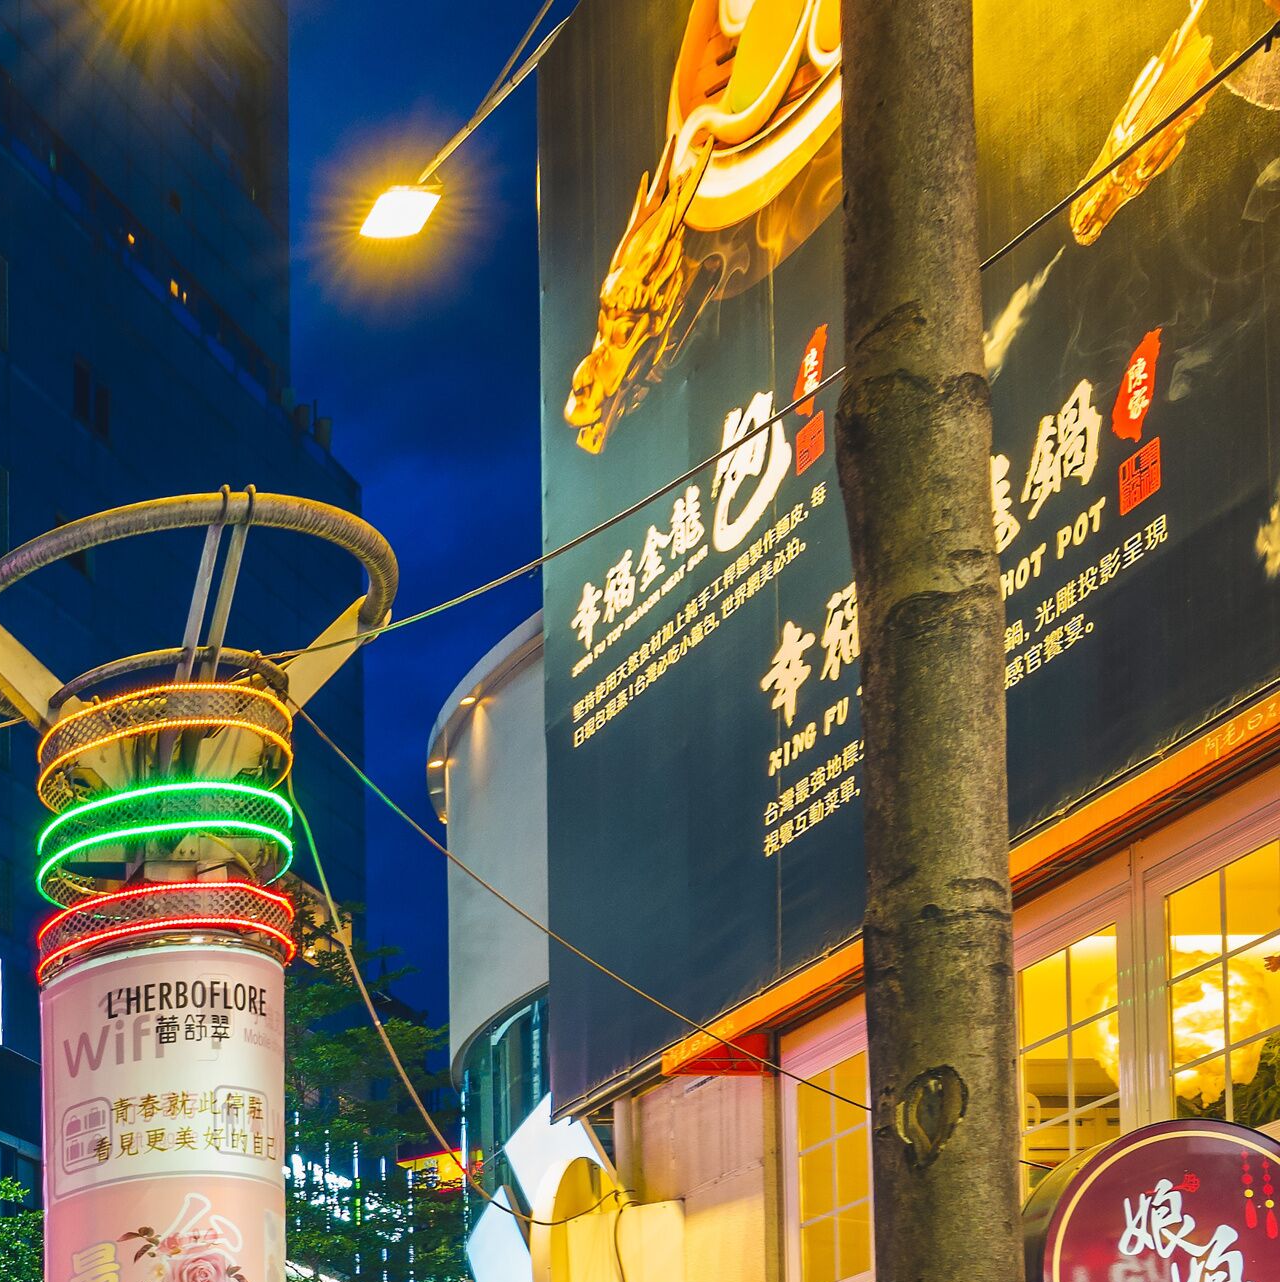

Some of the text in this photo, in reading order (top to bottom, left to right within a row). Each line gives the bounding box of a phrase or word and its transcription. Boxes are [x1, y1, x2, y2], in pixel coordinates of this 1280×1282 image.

[1001, 496, 1108, 602] HOT POT
[155, 1014, 231, 1045] 蕾舒翠
[111, 1091, 263, 1124] 青春就此停駐
[93, 1128, 277, 1162] 看見更美好的自己
